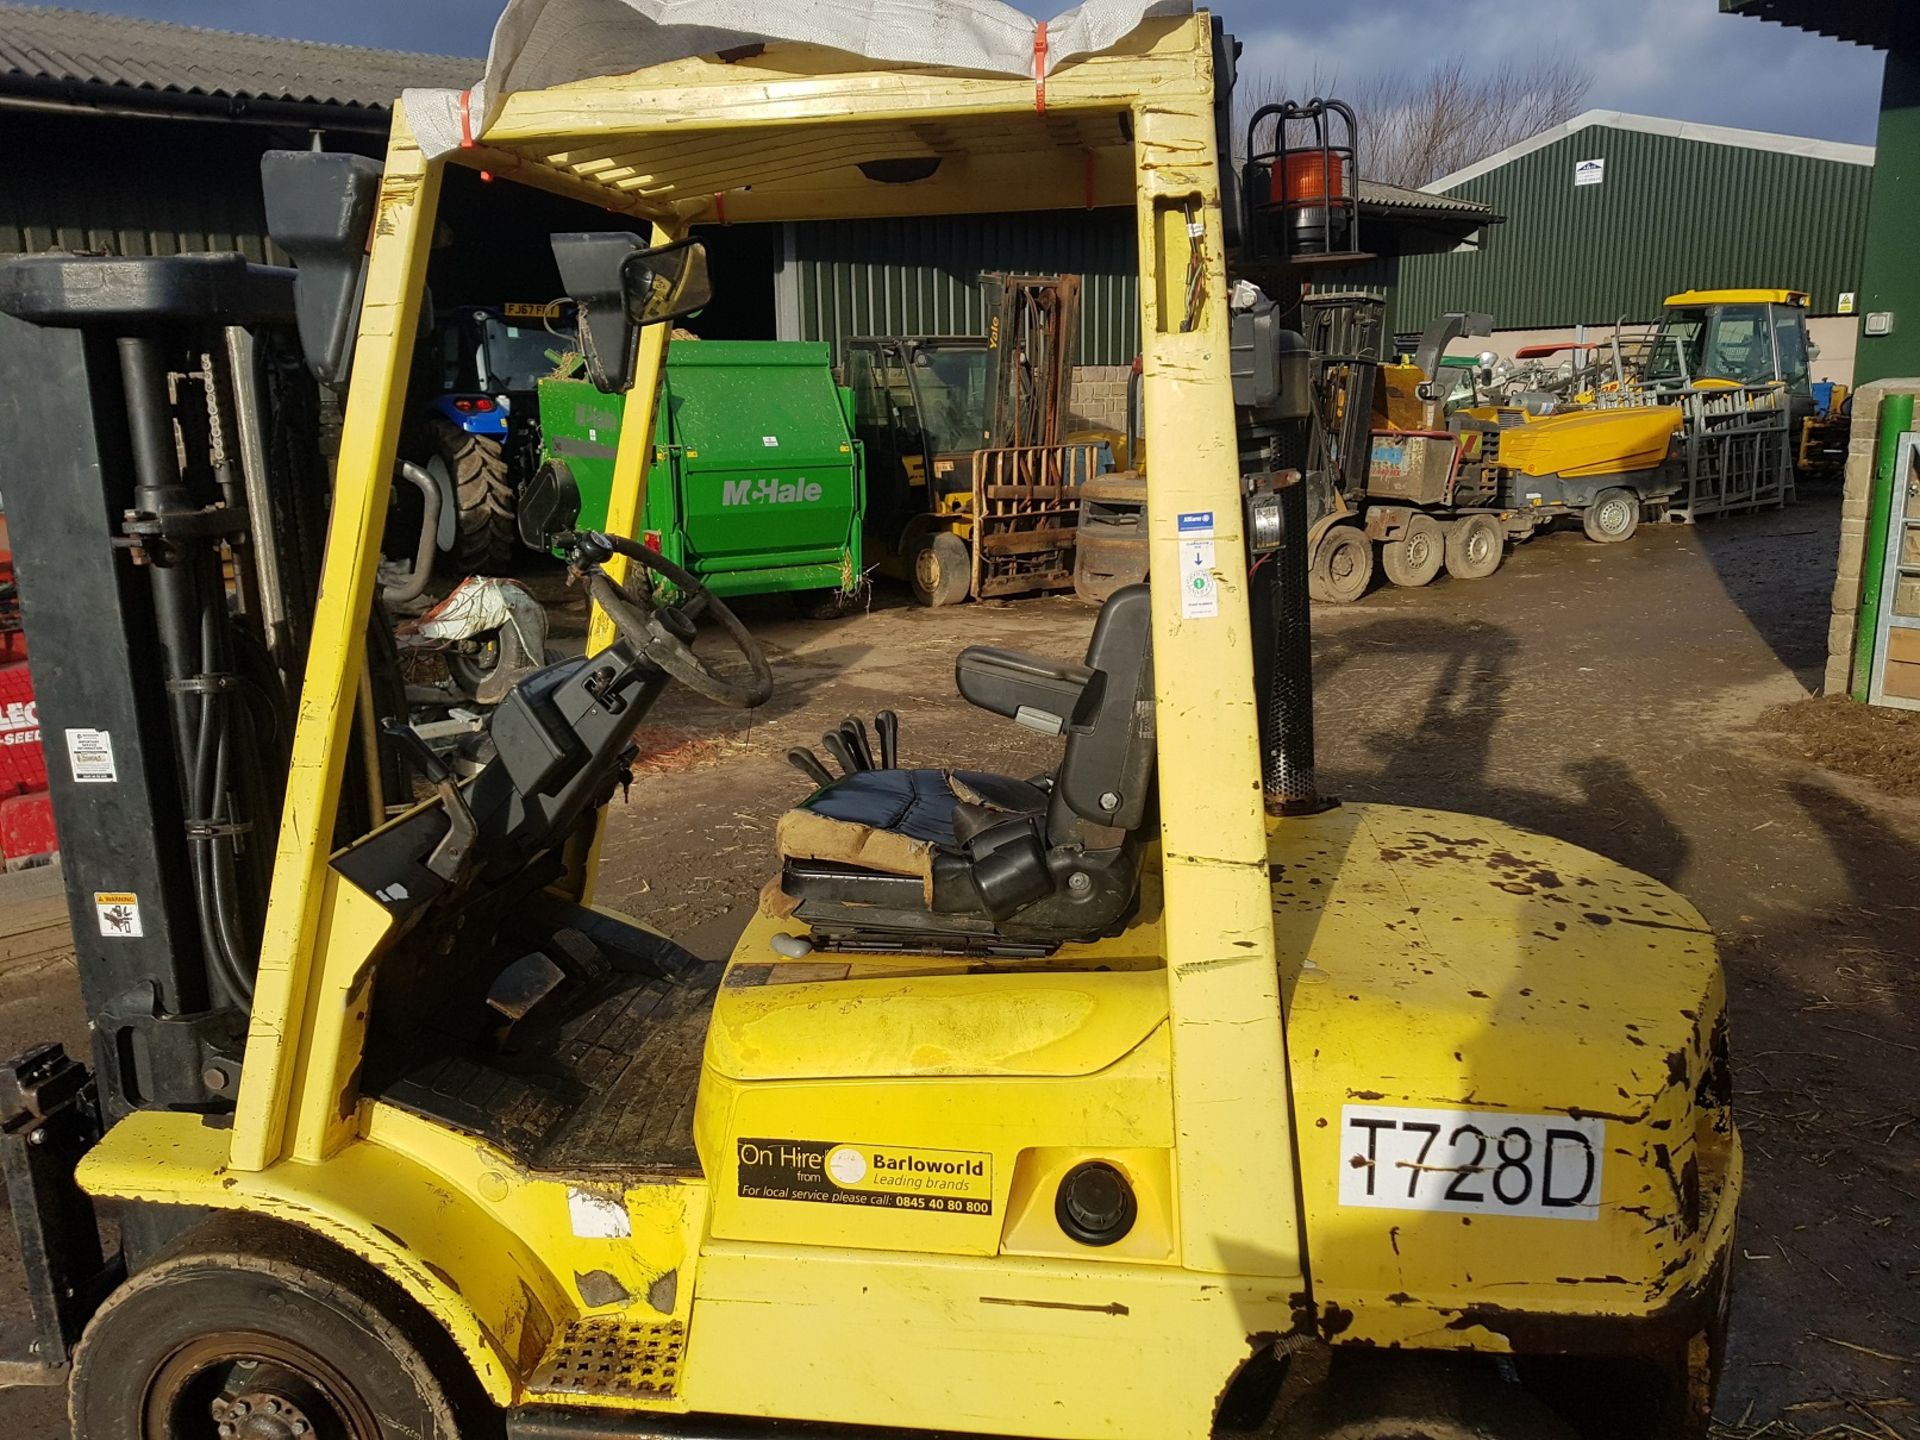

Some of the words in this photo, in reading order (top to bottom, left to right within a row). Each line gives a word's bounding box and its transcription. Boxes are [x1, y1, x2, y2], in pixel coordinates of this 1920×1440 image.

[989, 316, 999, 348] Yale
[722, 477, 822, 506] McHale
[740, 1144, 773, 1167] On
[781, 1146, 822, 1169] Hire
[873, 1154, 984, 1177] Barloworld
[1350, 1117, 1595, 1207] T728D
[797, 1170, 821, 1183] from
[873, 1173, 923, 1190] Leading
[926, 1176, 970, 1191] brands
[742, 1185, 761, 1196] For
[763, 1186, 789, 1198] local
[792, 1189, 829, 1201] service
[832, 1191, 868, 1205] please
[870, 1193, 893, 1206] call:
[896, 1195, 926, 1208] 0845
[928, 1197, 945, 1209] 40
[947, 1198, 963, 1211] 80
[966, 1199, 989, 1213] 800
